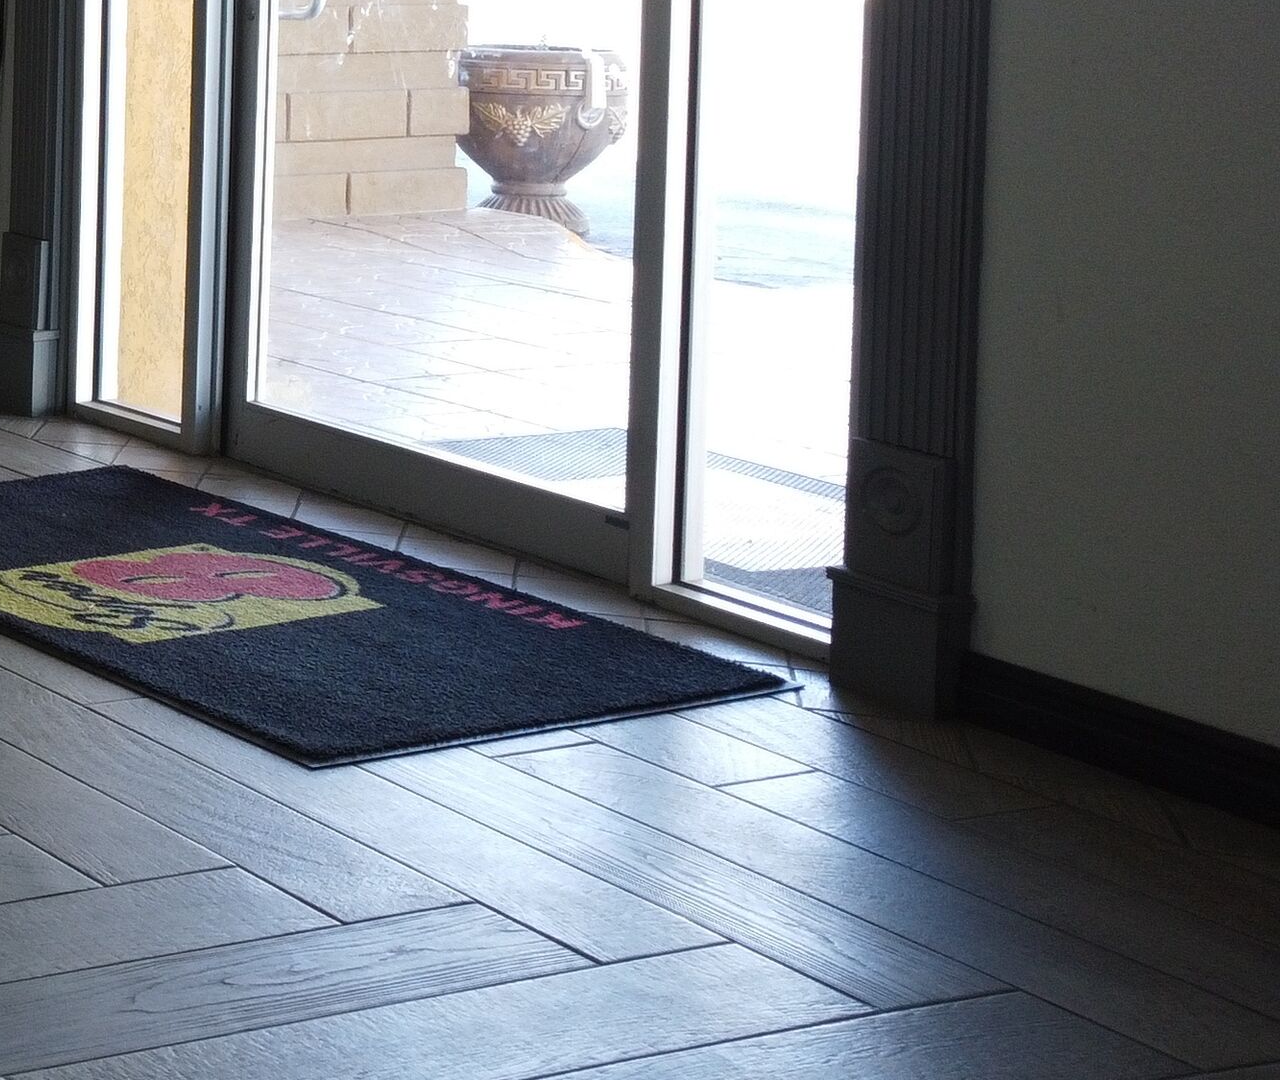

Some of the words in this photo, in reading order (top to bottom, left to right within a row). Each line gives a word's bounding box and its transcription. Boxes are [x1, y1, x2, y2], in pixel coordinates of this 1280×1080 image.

[189, 502, 258, 527] TX
[17, 571, 200, 632] Super
[70, 552, 342, 602] 8
[259, 525, 586, 630] KINGSVILLE
